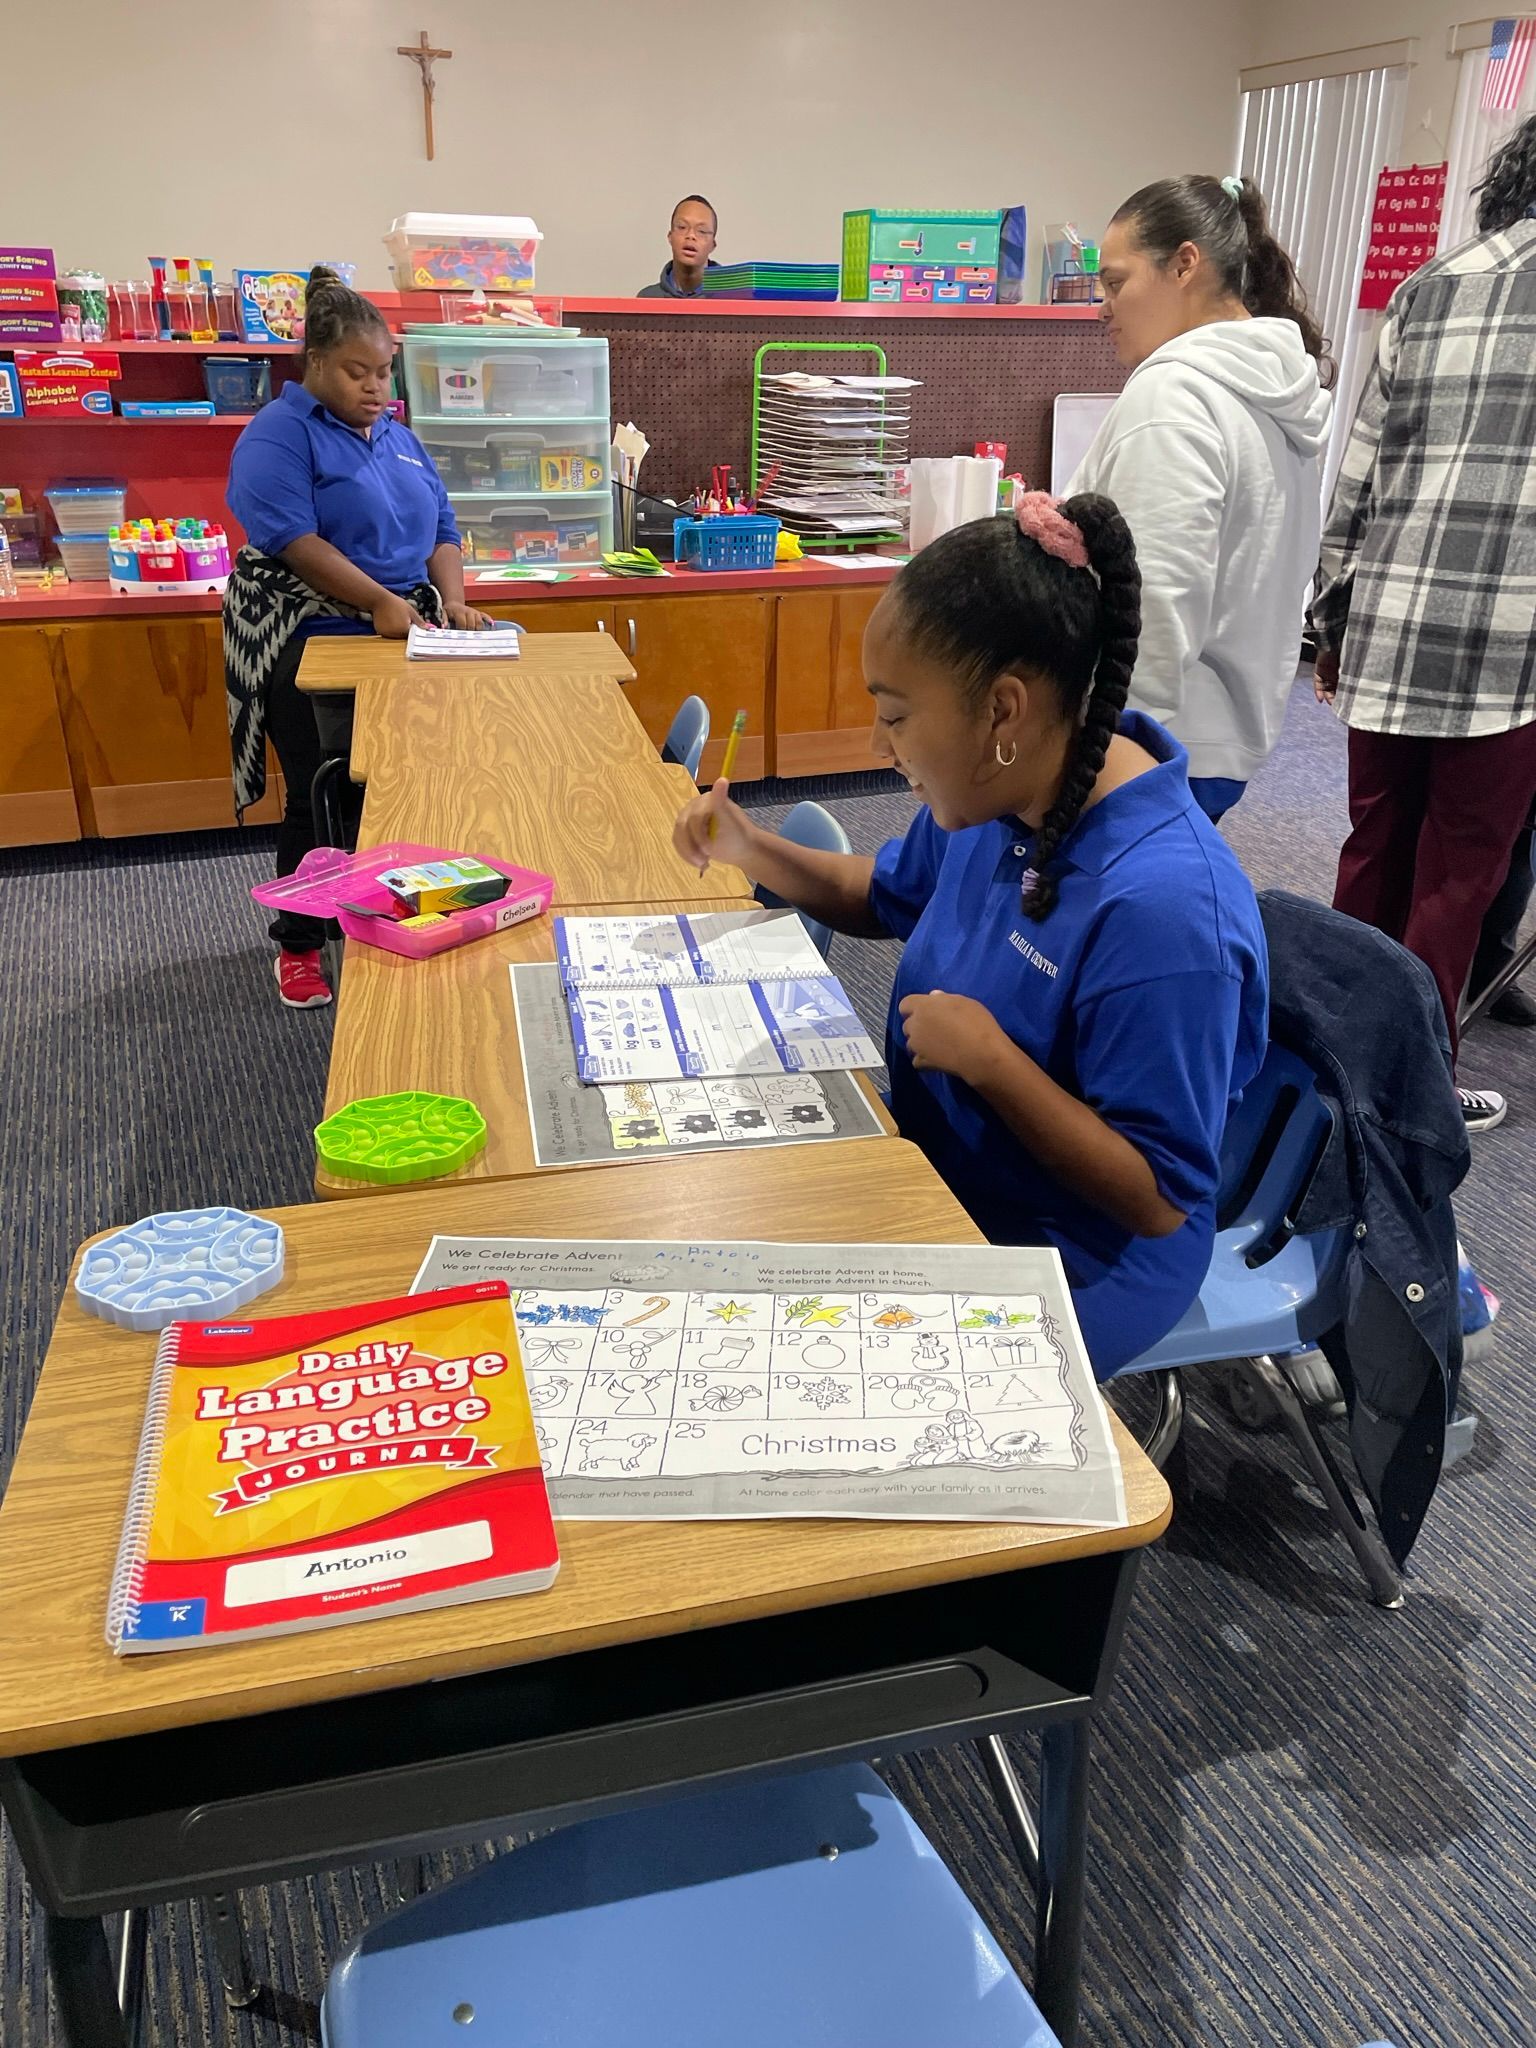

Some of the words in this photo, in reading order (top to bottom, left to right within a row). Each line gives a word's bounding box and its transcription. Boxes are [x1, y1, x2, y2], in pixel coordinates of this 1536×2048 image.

[1409, 175, 1419, 186] Cc
[1423, 174, 1436, 185] Dd
[1390, 199, 1402, 211] Gg
[19, 367, 51, 377] Instant
[52, 368, 89, 377] Learning
[26, 384, 77, 399] Alphabet
[502, 902, 537, 922] Chelsea
[1008, 929, 1035, 959] MARIAN
[1030, 951, 1059, 979] CENTER
[711, 1097, 731, 1108] 16
[765, 1093, 784, 1105] 23
[552, 1111, 565, 1145] Celebrate
[725, 1129, 744, 1140] 15
[777, 1123, 798, 1135] 22
[448, 1249, 472, 1259] We
[478, 1249, 560, 1260] Celebrate
[565, 1250, 625, 1261] Advent
[442, 1263, 459, 1271] We
[462, 1264, 481, 1273] get
[483, 1263, 517, 1273] ready
[520, 1263, 536, 1272] for
[778, 1268, 831, 1276] celebrate
[835, 1268, 875, 1276] Advent
[893, 1269, 928, 1278] home.
[892, 1279, 934, 1287] church.
[522, 1291, 539, 1304] 2
[608, 1291, 623, 1305] 3
[690, 1294, 705, 1307] 4
[777, 1294, 791, 1307] 5
[863, 1294, 878, 1307] 6
[957, 1296, 970, 1309] 7
[601, 1330, 625, 1344] 10
[685, 1330, 704, 1344] 11
[777, 1332, 802, 1346] 12
[866, 1335, 890, 1349] 13
[965, 1335, 991, 1349] 14
[300, 1342, 411, 1376] Daily
[198, 1353, 505, 1419] Language
[588, 1372, 614, 1388] 17
[680, 1373, 708, 1388] 18
[773, 1374, 800, 1390] 19
[869, 1375, 899, 1390] 20
[968, 1374, 995, 1388] 21
[221, 1398, 488, 1461] Practice
[576, 1419, 609, 1435] 24
[674, 1422, 706, 1439] 25
[741, 1433, 897, 1457] Christmas
[254, 1443, 456, 1489] JOURNAL
[623, 1490, 651, 1498] have
[653, 1489, 695, 1499] passed.
[739, 1488, 752, 1496] At
[756, 1489, 789, 1497] home
[792, 1489, 822, 1497] color
[858, 1486, 880, 1495] day
[884, 1483, 907, 1492] with
[910, 1484, 937, 1494] your
[941, 1483, 975, 1495] family
[978, 1485, 991, 1493] as
[994, 1484, 1001, 1493] it
[1004, 1485, 1048, 1495] arrives.
[303, 1549, 408, 1578] Antonio
[321, 1588, 369, 1603] Student's
[371, 1582, 403, 1594] Name
[172, 1610, 187, 1622] K
